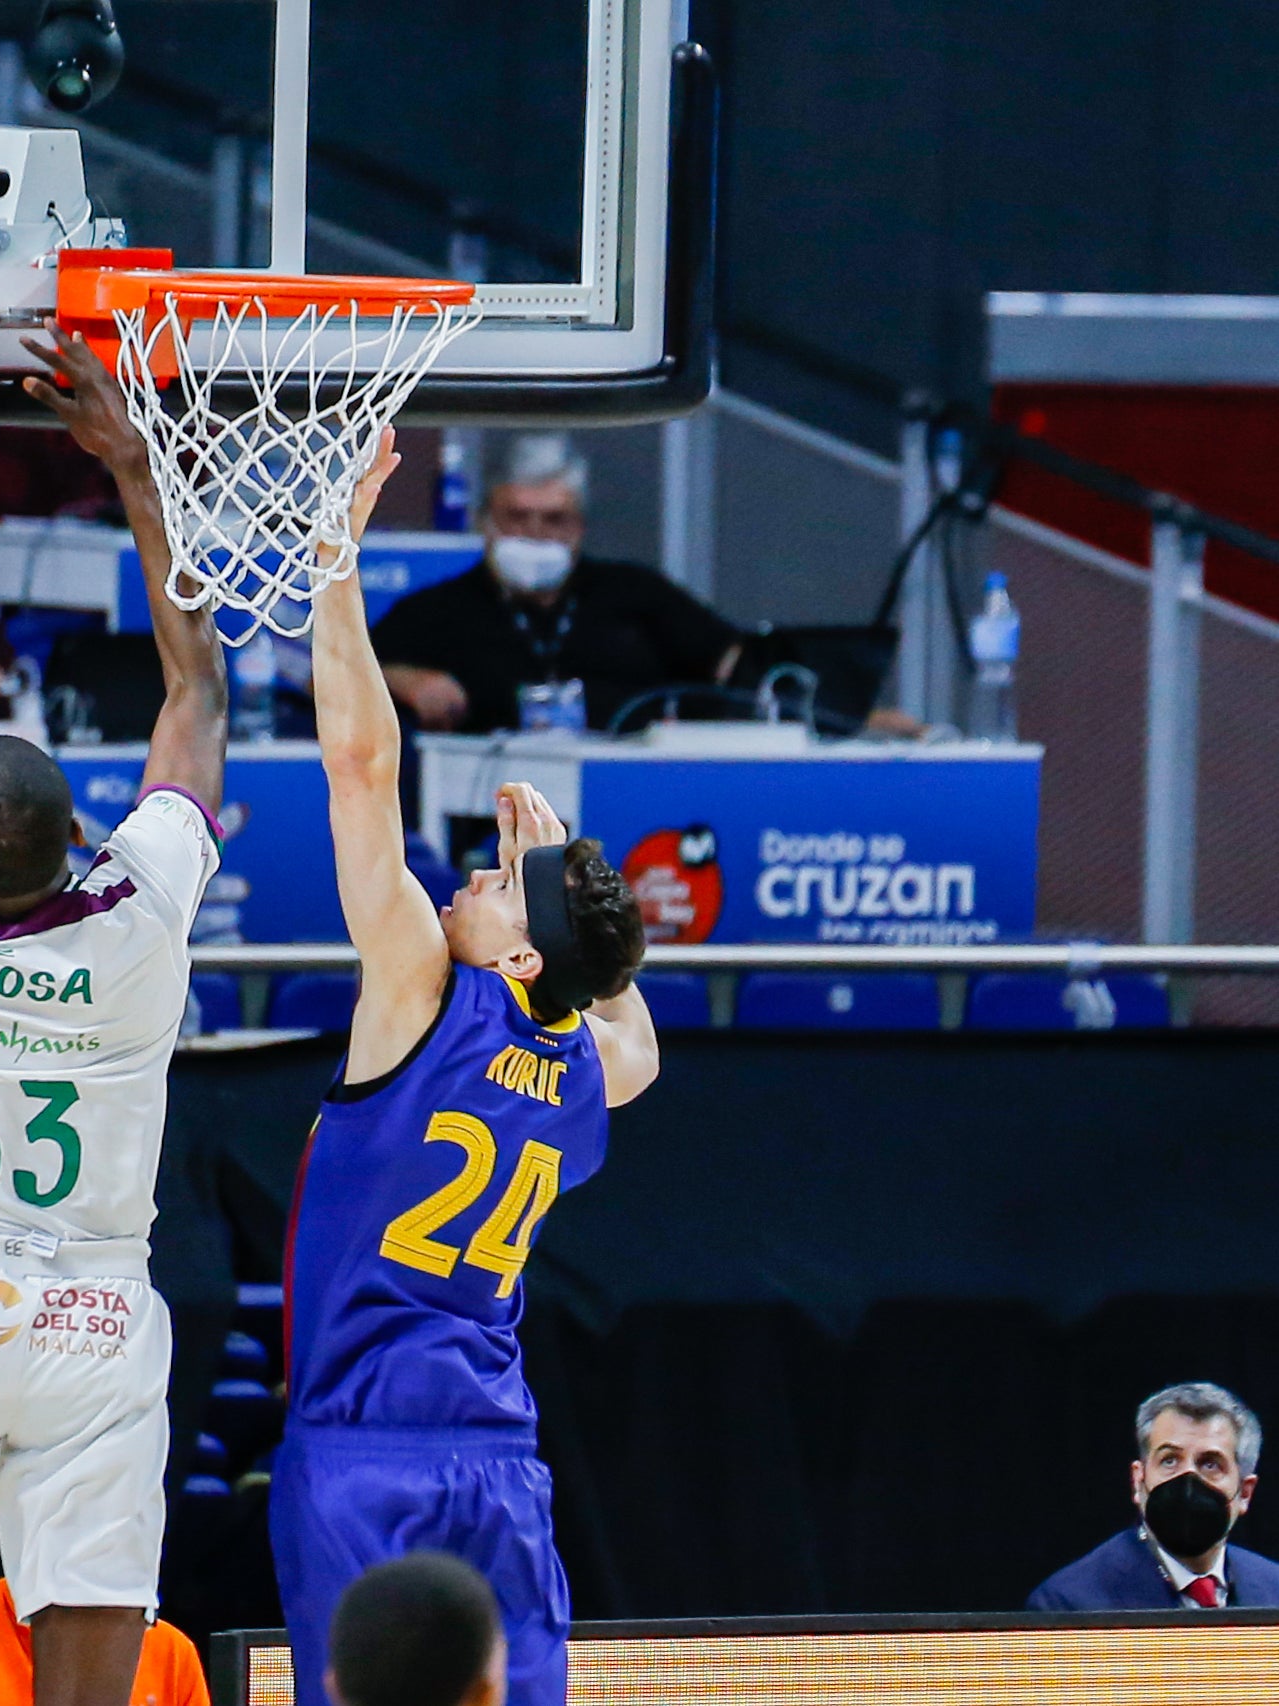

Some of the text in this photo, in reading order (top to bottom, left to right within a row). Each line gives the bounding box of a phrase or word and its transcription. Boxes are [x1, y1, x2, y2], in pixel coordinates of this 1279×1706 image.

[759, 829, 906, 863] Donde se
[756, 864, 975, 918] cruzan
[486, 1044, 568, 1106] KURIC
[379, 1111, 562, 1299] 24
[43, 1288, 132, 1315] COSTA
[32, 1312, 127, 1340] DEL SOL
